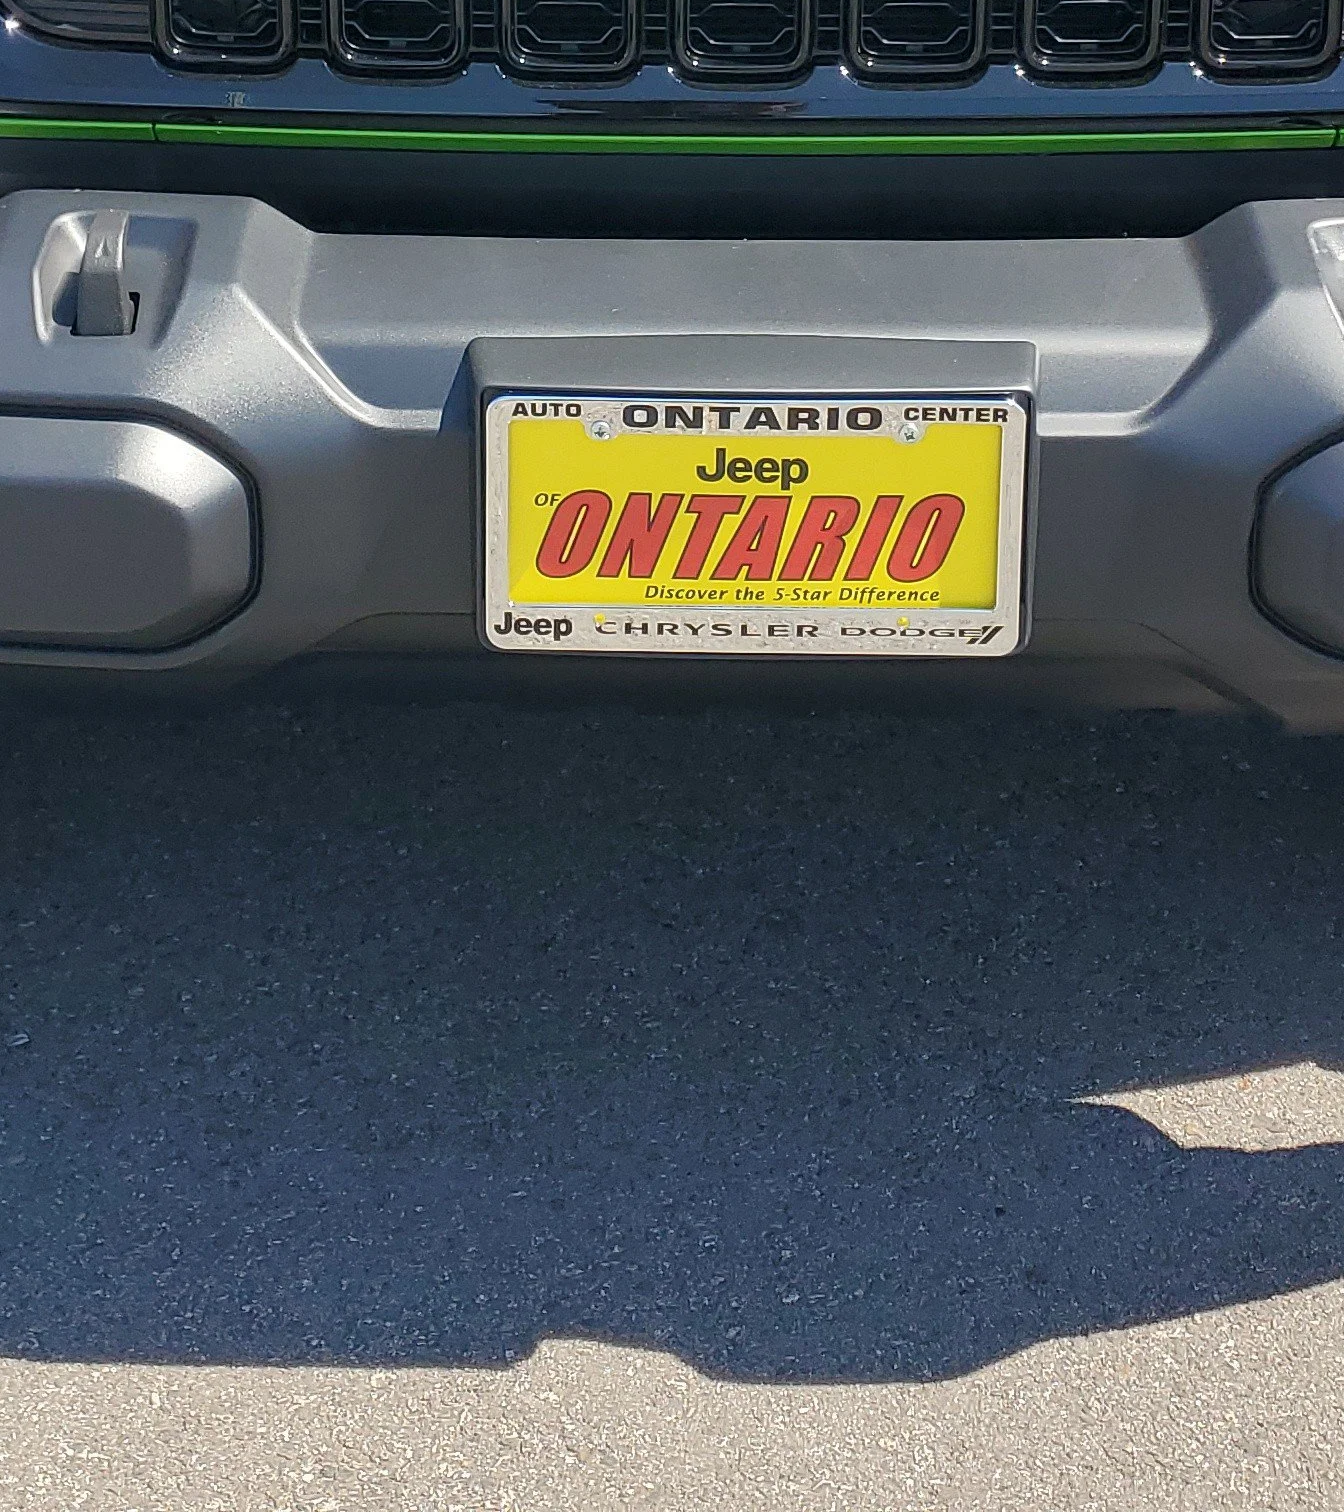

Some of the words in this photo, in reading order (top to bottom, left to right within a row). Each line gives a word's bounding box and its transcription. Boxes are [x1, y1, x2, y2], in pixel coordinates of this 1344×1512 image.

[512, 403, 582, 417] AUTO
[622, 404, 883, 431] ONTARIO
[903, 407, 1008, 423] CENTER
[696, 447, 809, 490] Jeep
[534, 493, 560, 507] OF
[535, 489, 966, 583] ONTARIO
[644, 585, 729, 601] Discover
[735, 587, 765, 601] the
[772, 587, 833, 602] 5-Star
[838, 586, 941, 604] Difference
[494, 611, 573, 640] Jeep
[594, 621, 820, 638] CHRYSLER
[840, 625, 983, 638] DODGE
